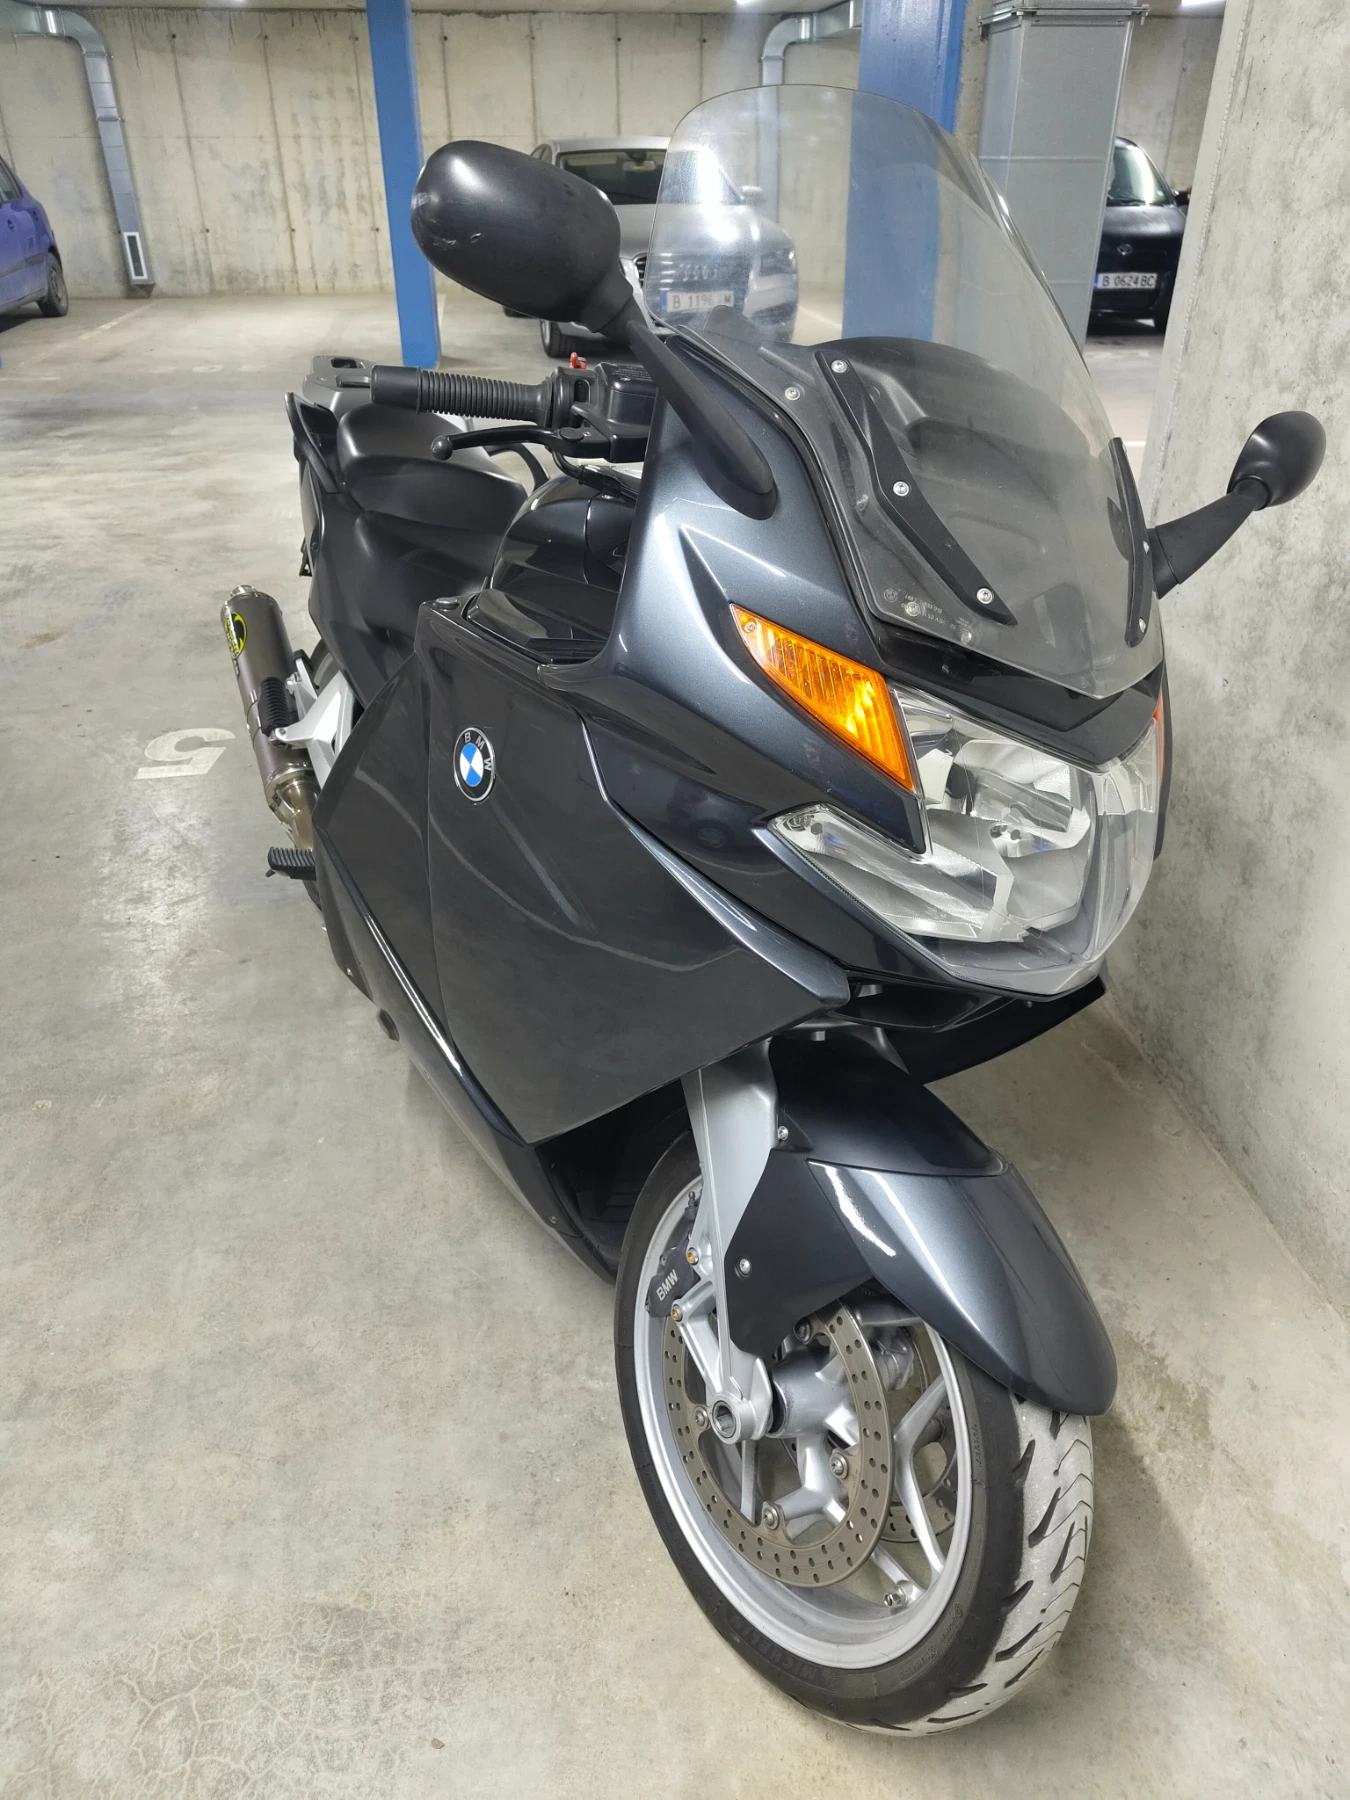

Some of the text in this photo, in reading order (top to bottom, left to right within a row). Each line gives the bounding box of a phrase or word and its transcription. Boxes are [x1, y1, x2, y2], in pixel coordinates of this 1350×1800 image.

[672, 295, 681, 309] B
[133, 727, 237, 780] 5
[464, 731, 493, 772] BMW
[656, 1268, 679, 1302] BMW
